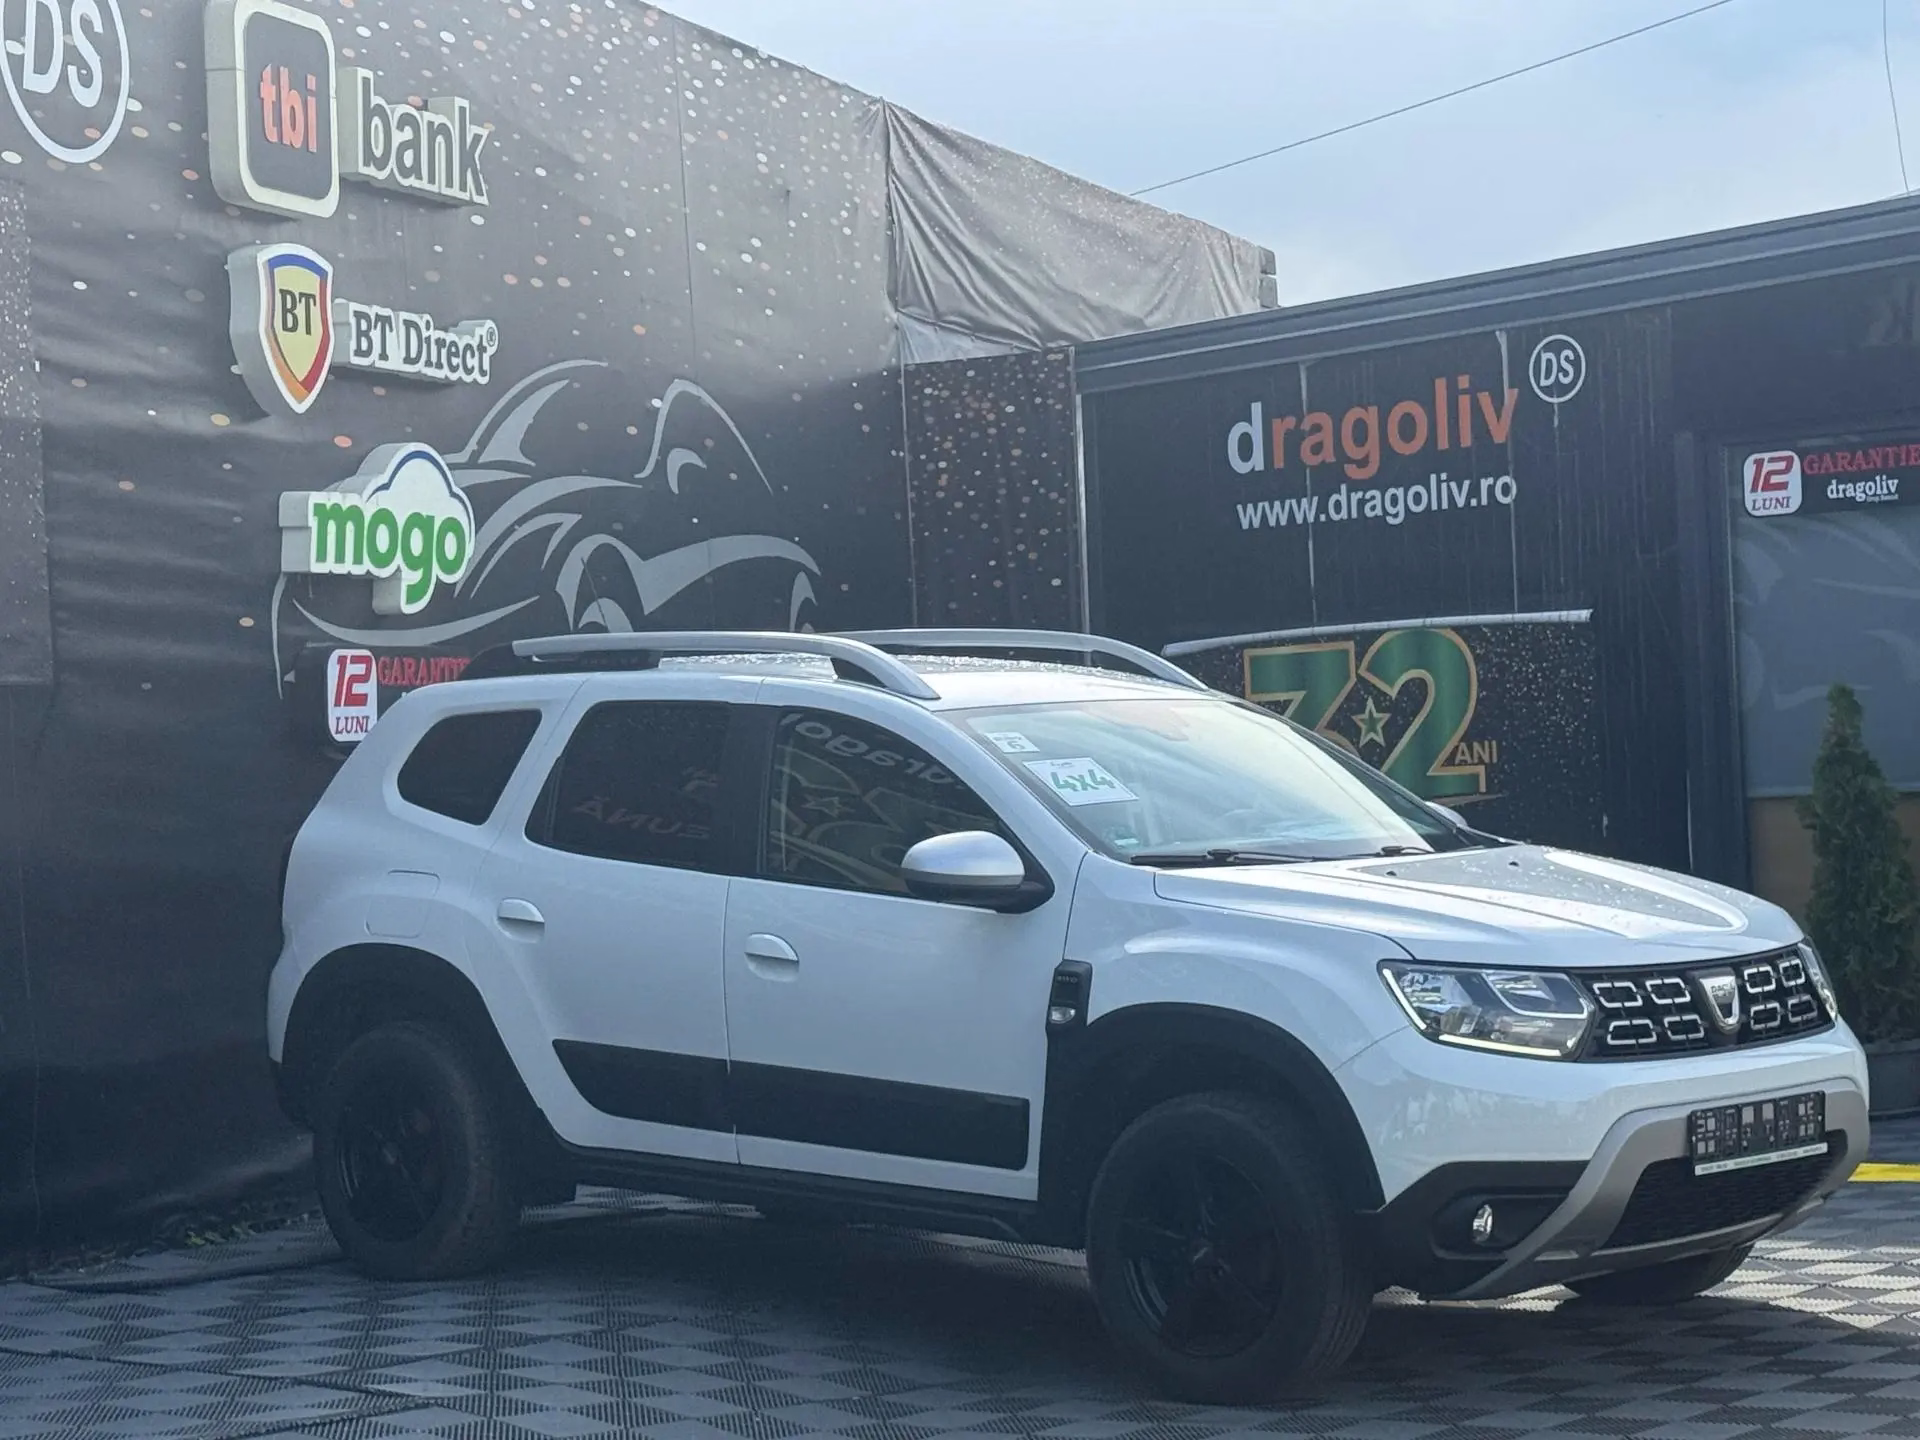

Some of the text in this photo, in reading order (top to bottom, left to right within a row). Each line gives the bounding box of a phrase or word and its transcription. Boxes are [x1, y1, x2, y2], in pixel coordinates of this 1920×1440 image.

[23, 0, 103, 108] DS
[260, 63, 317, 153] tbi
[361, 75, 488, 200] bank
[279, 287, 317, 336] BT
[352, 310, 393, 359] BT
[1539, 347, 1575, 387] DS
[1227, 375, 1519, 480] dragoliv
[1750, 455, 1794, 493] 12
[1803, 444, 1920, 474] GARANTIE
[1237, 473, 1518, 527] www.dragoliv.ro
[1751, 496, 1791, 512] LUNI
[1827, 474, 1899, 502] dragoliv
[314, 502, 467, 605] mogo
[334, 655, 373, 707] 12
[334, 715, 371, 735] LUNI
[1455, 740, 1498, 766] ANI
